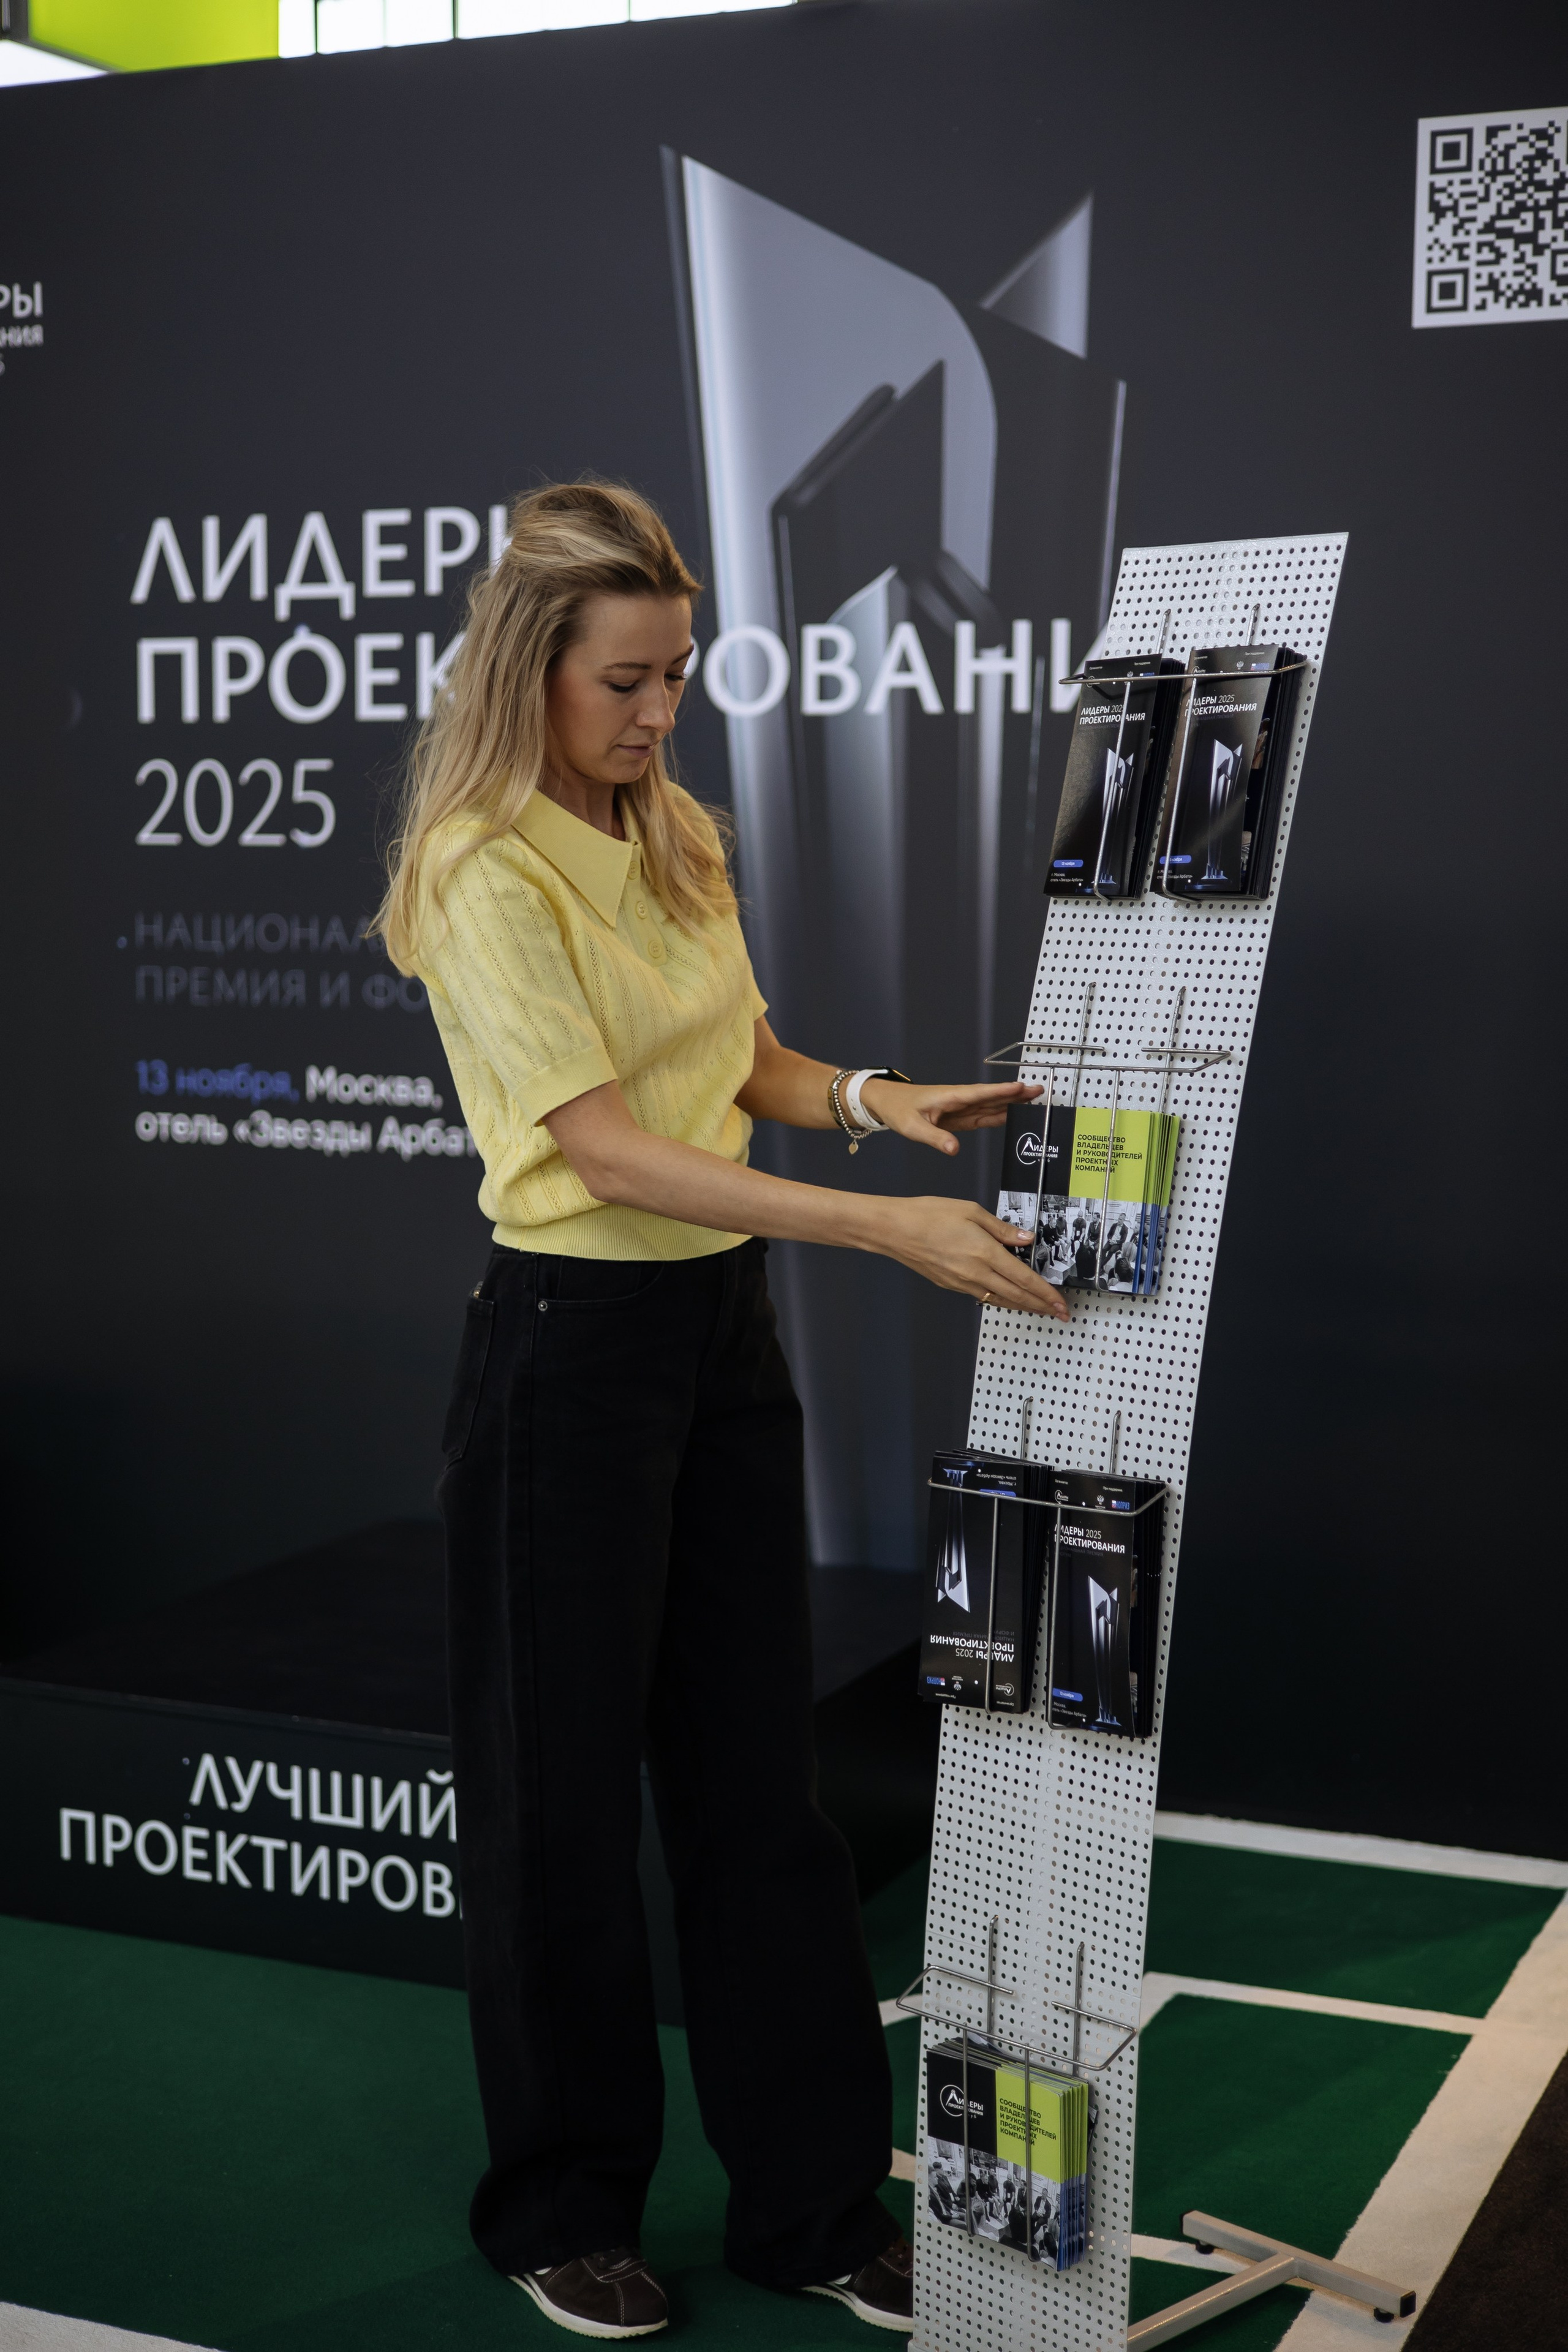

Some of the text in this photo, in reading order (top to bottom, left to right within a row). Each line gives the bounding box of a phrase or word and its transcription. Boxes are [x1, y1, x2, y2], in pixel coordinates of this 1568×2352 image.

[1218, 694, 1235, 704] 2025
[1079, 712, 1145, 725] ПРОЕКТИРОАНИЯ
[1080, 705, 1110, 715] ЛИДЕРЫ
[1184, 703, 1257, 717] ПОЕКТИРОВАНИЯ
[135, 758, 336, 848] 2025
[135, 911, 386, 959] НАЦИОНАЛ
[135, 965, 307, 1009] ПРЕМИЯ
[318, 970, 351, 1009] И
[135, 1058, 443, 1112] 13 ноября, Москва,
[135, 1110, 228, 1145] отель
[233, 1108, 372, 1158] «Звезды
[1075, 1164, 1115, 1173] КОМПАНЙ
[1085, 1529, 1102, 1539] 2025
[955, 1648, 974, 1658] 2025
[189, 1752, 458, 1844] ЛУЧШИЙ
[60, 1807, 462, 1920] ПРОЕКТИРОВ
[948, 2103, 984, 2116] ПРОЕКТОВАНИЯ
[1000, 2098, 1041, 2119] СООБЩЕТВО
[1000, 2105, 1040, 2126] ВЛАДЕЛЦЕВ
[1000, 2127, 1035, 2146] КОМПАНЙ
[1006, 2115, 1057, 2141] РУКОВДИТЕЛЕЙ
